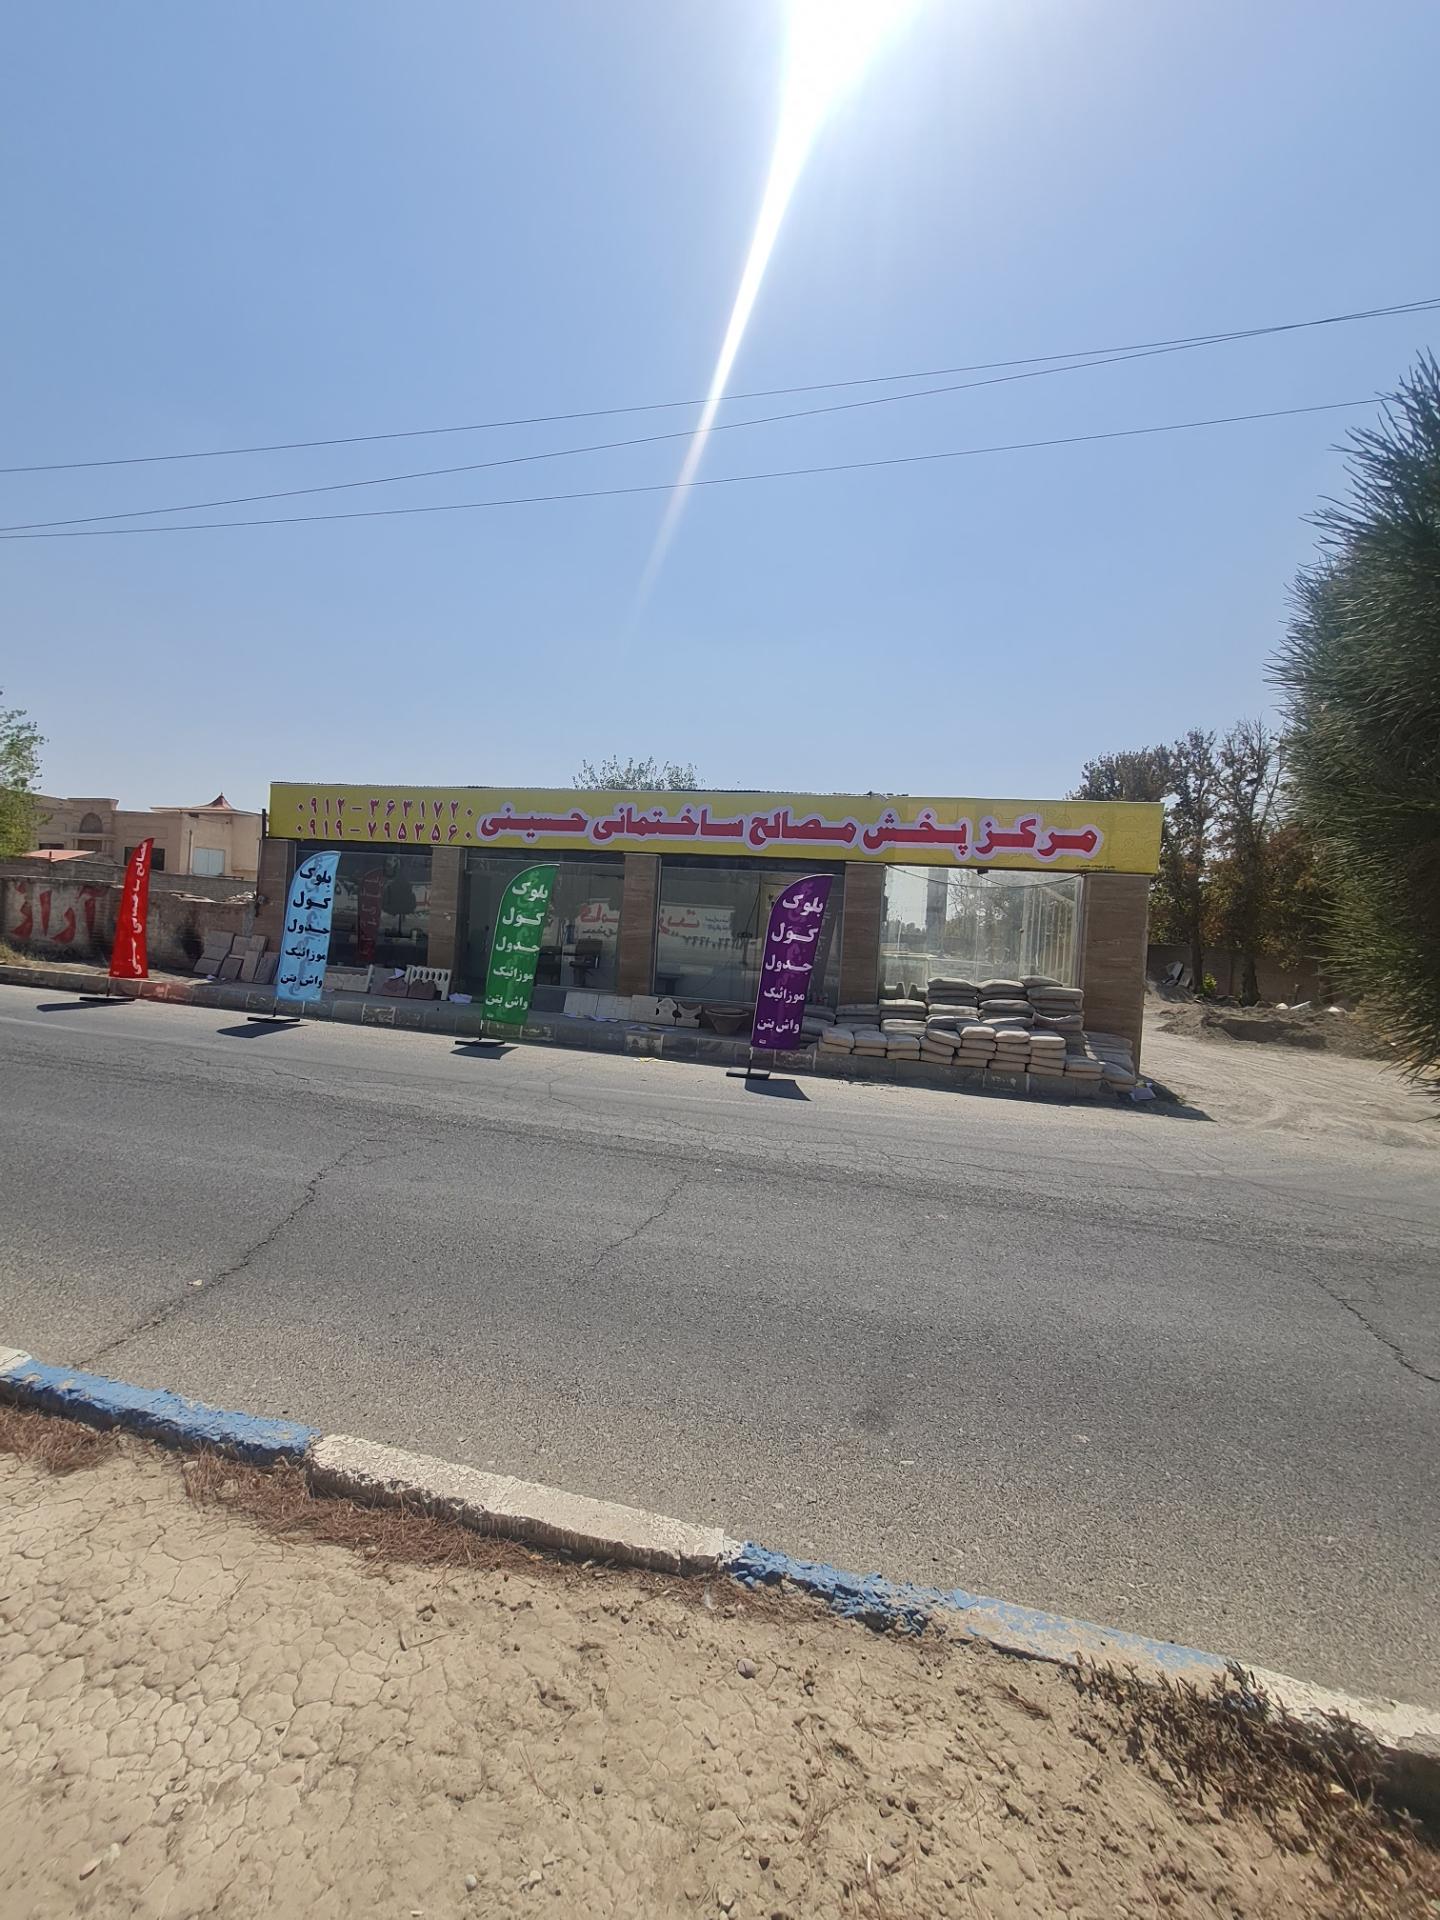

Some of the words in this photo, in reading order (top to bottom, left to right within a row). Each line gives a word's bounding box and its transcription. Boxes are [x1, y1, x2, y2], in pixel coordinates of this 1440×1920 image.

[480, 807, 589, 838] حسینی
[592, 807, 744, 840] ساختمانی
[749, 810, 857, 846] مصالح
[863, 811, 969, 858] پخش
[975, 818, 1098, 857] مرکز
[299, 867, 332, 888] بلوک
[512, 881, 549, 902] بلوک
[782, 894, 824, 917] بلوک
[287, 919, 330, 938] جدول
[495, 936, 541, 956] جدول
[765, 954, 813, 975] جدول
[504, 995, 529, 1011] واش
[775, 1018, 800, 1034] واش
